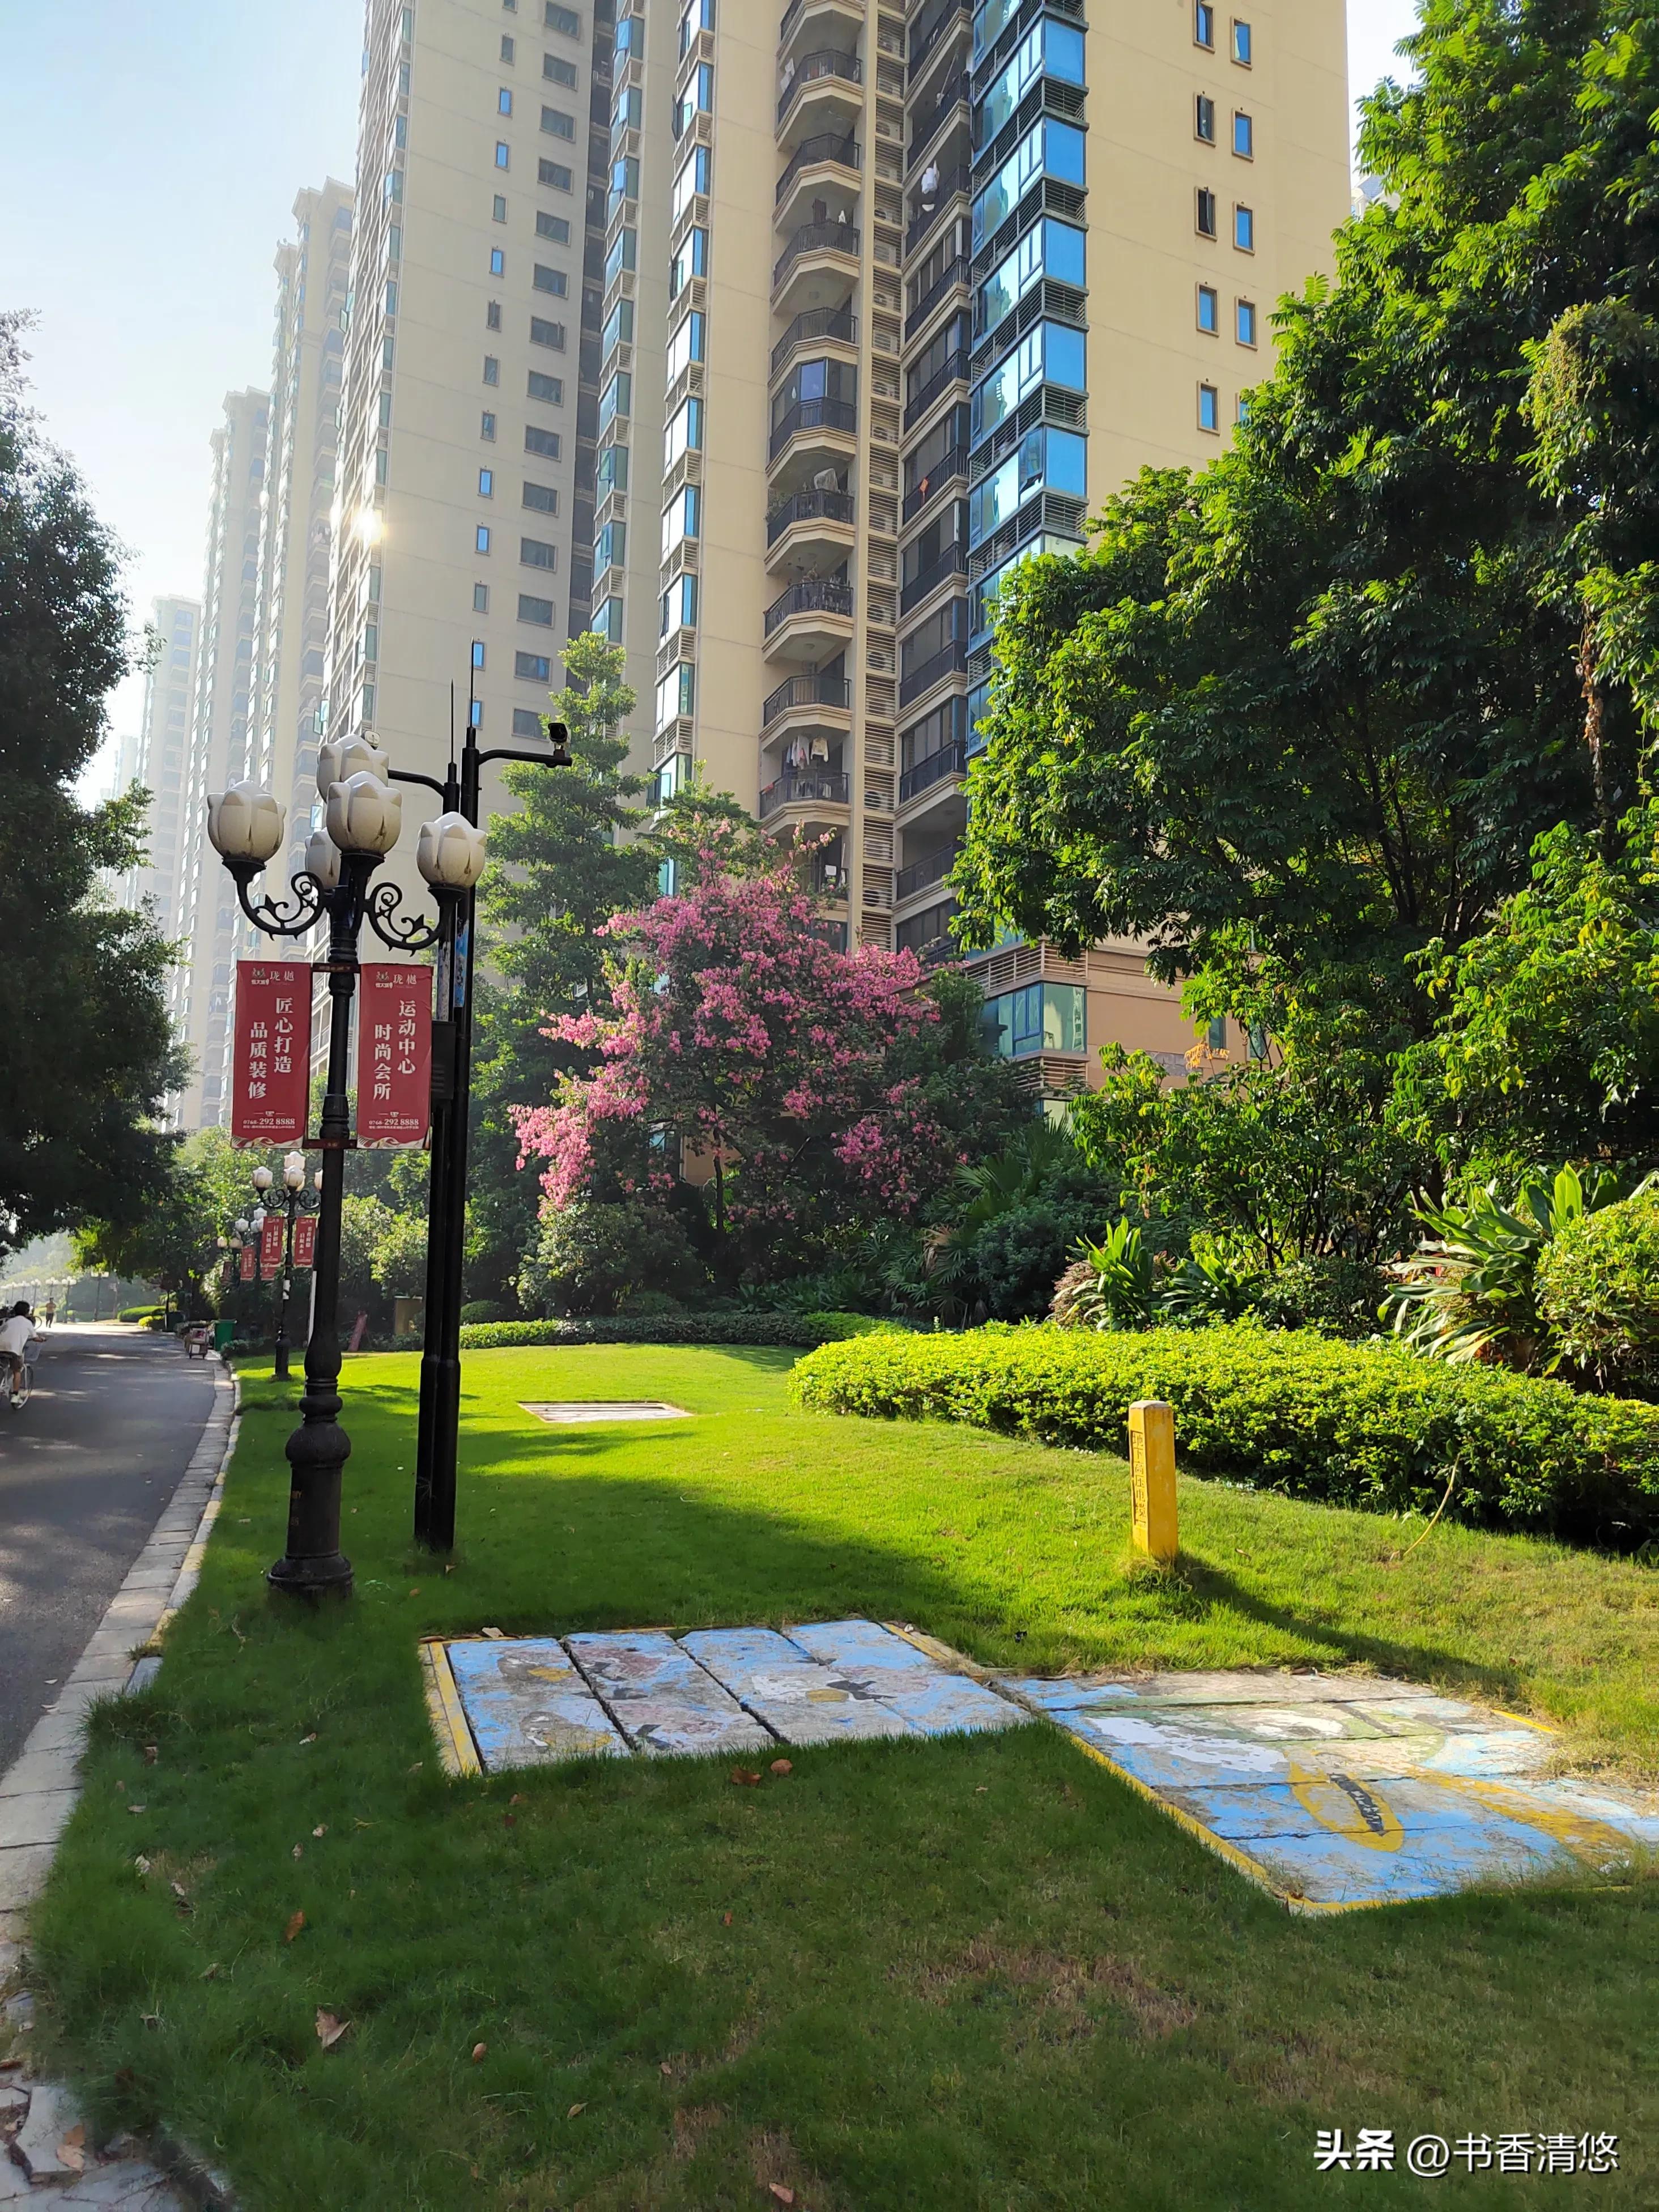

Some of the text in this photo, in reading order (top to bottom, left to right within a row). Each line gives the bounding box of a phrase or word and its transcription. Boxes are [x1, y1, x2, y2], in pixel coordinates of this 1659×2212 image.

[248, 1022, 268, 1099] 品质装修
[274, 997, 294, 1074] 匠心打造
[373, 1024, 393, 1100] 时尚会所
[397, 1000, 416, 1074] 运动中心
